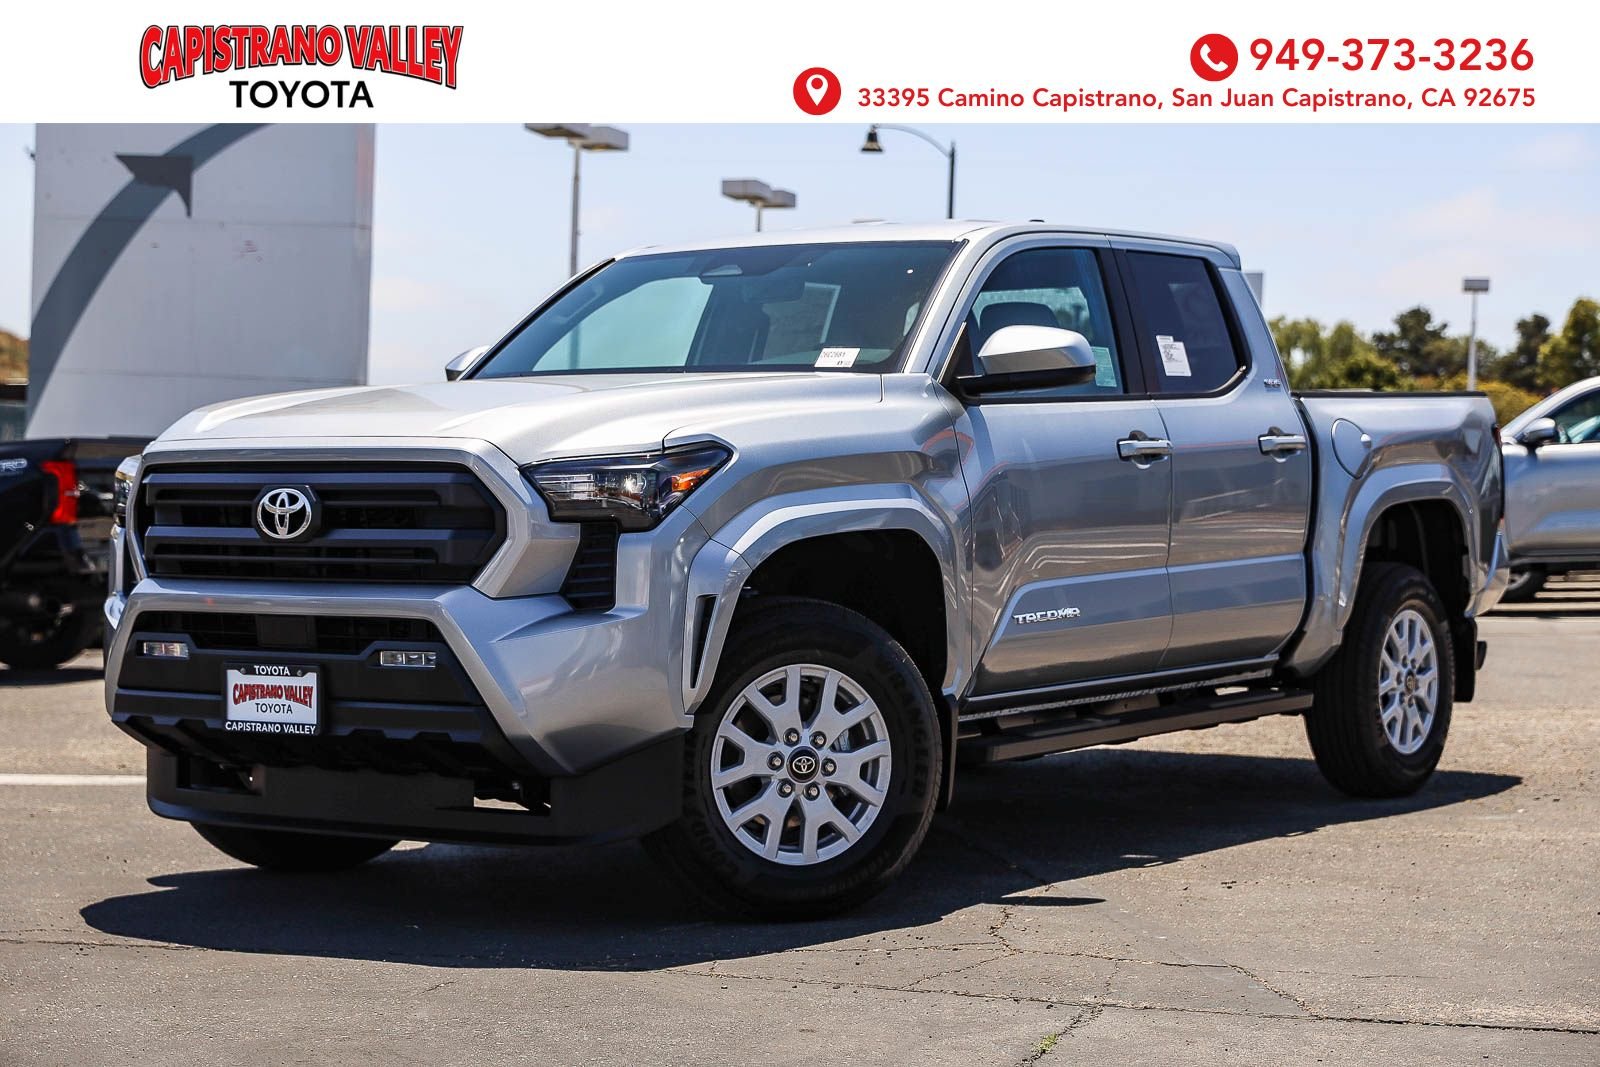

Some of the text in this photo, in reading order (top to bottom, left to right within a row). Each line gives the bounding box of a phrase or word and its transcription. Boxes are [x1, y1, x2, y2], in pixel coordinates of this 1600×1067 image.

[1013, 607, 1080, 624] TACOMA
[254, 665, 290, 676] TOYOTA
[233, 683, 313, 708] CAPISTRANO VALLEY
[255, 702, 293, 715] TOYOTA
[225, 721, 316, 735] CAPISTRANO VALLEY
